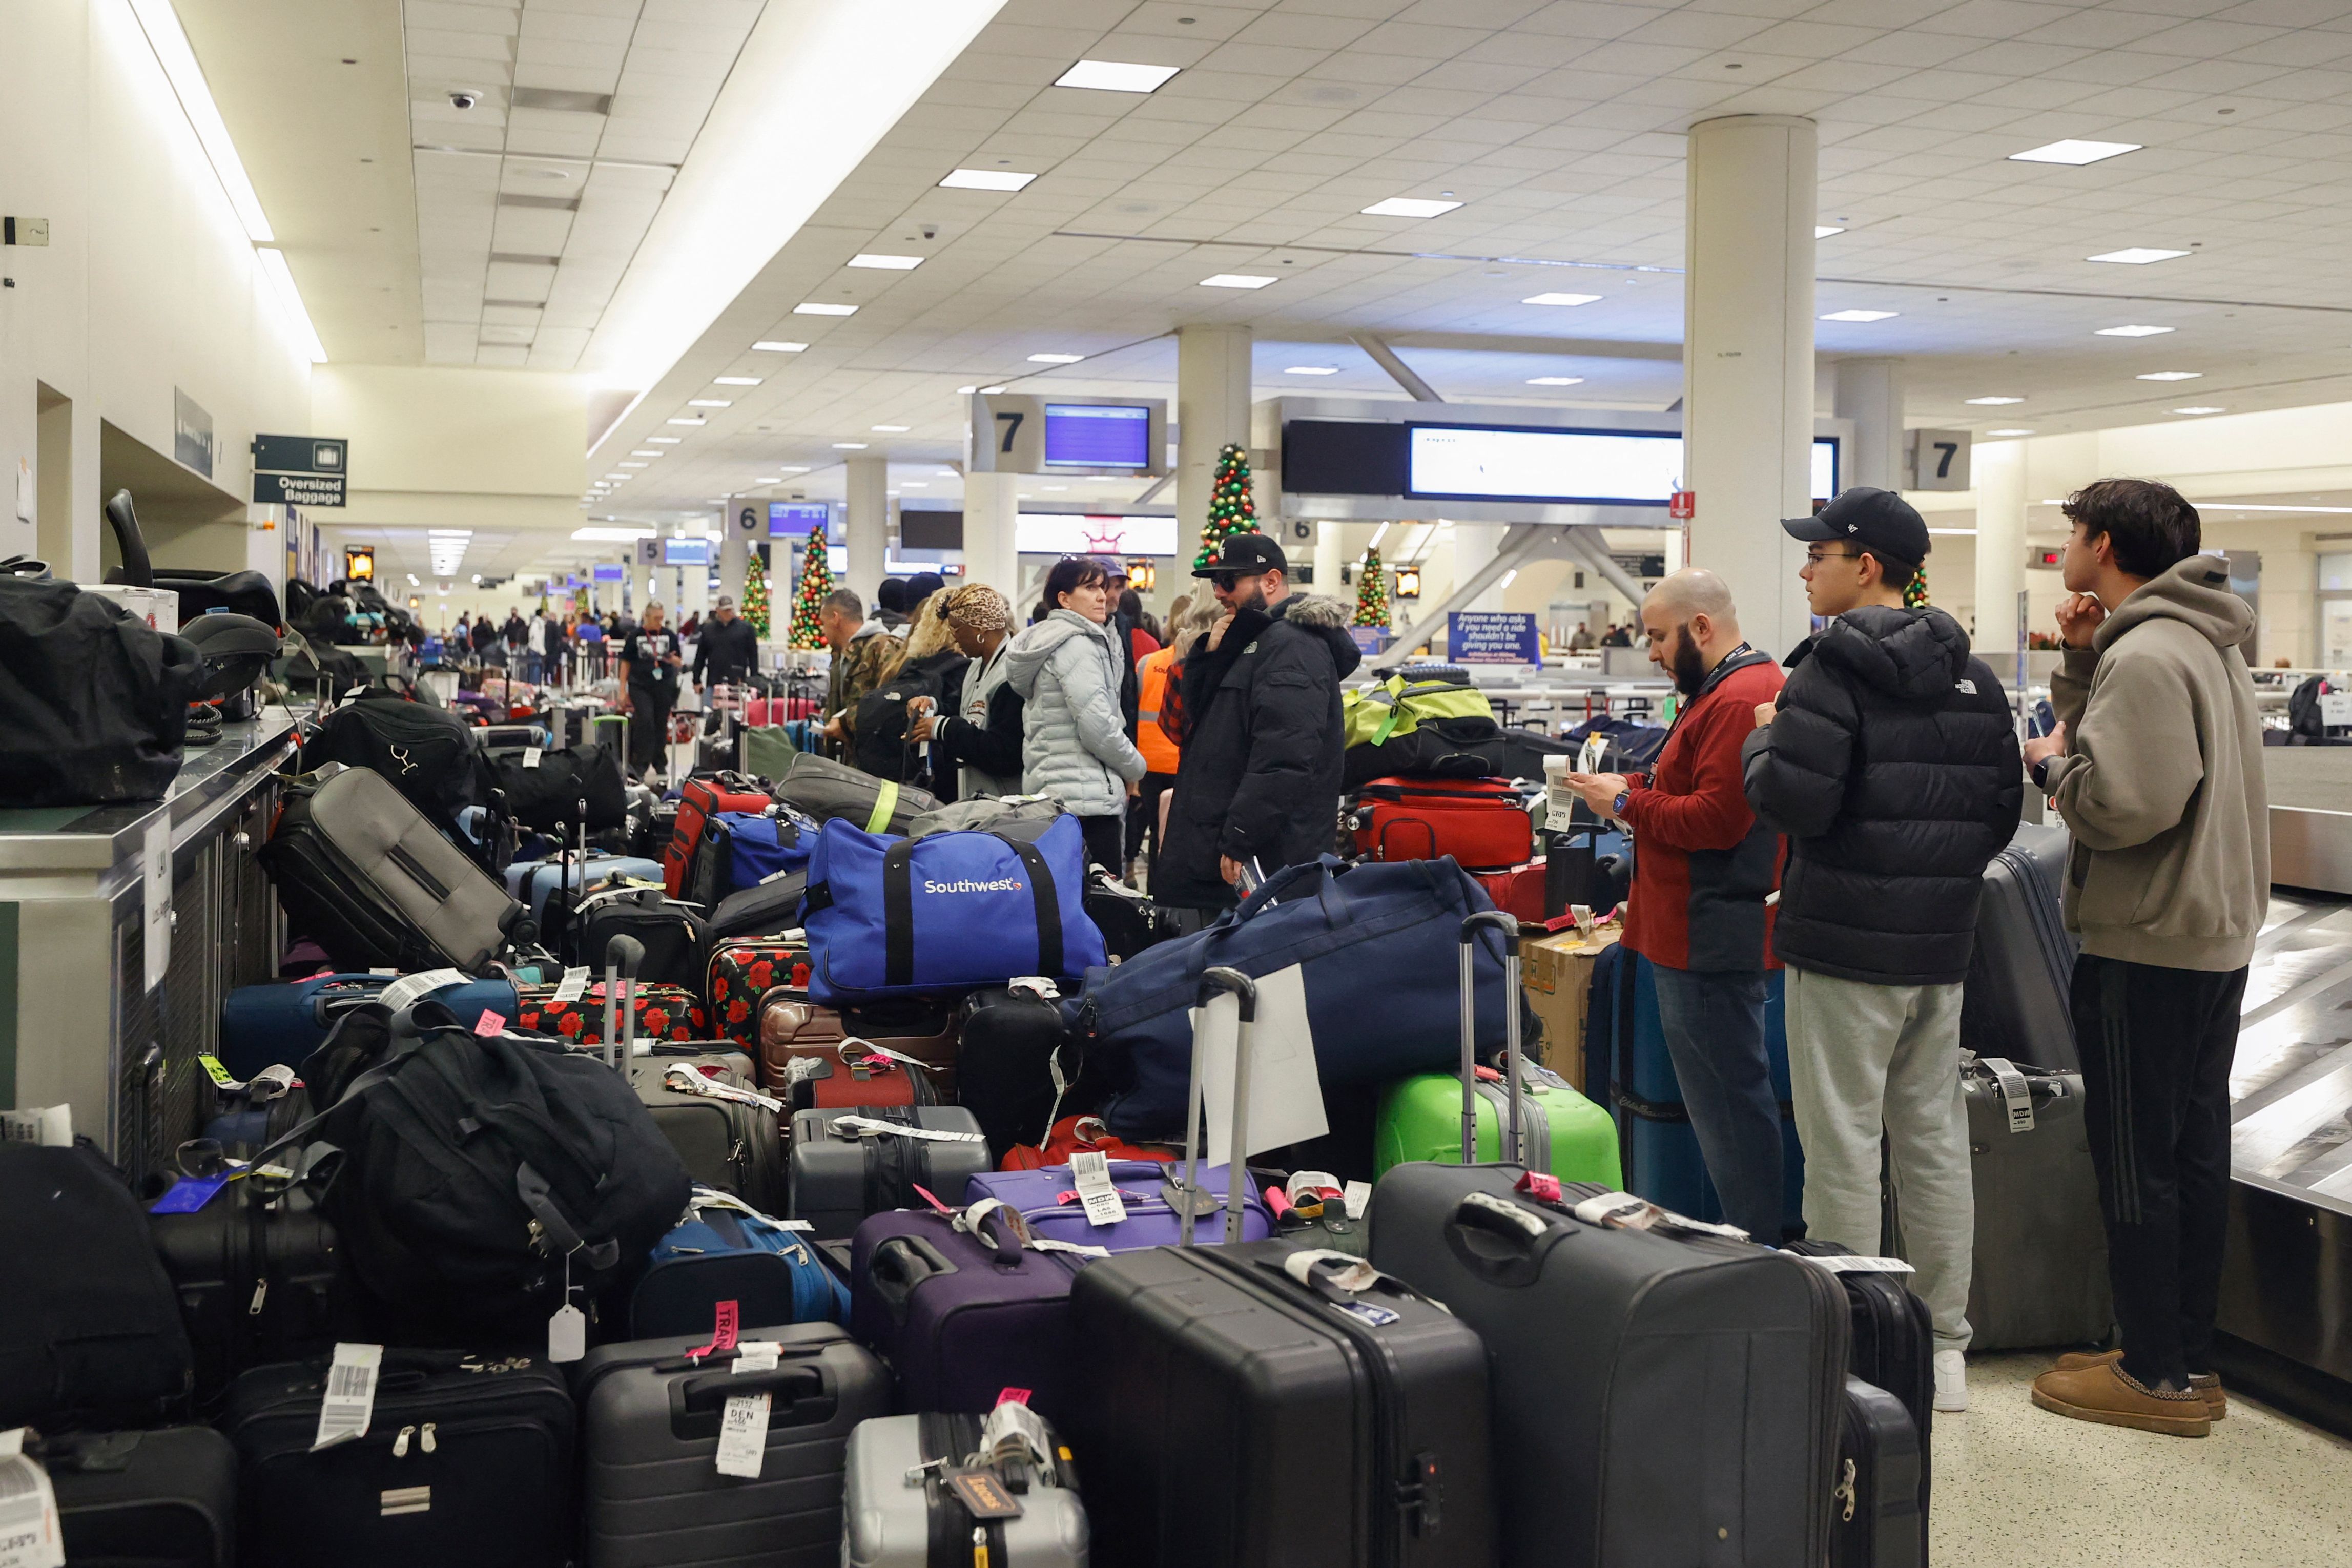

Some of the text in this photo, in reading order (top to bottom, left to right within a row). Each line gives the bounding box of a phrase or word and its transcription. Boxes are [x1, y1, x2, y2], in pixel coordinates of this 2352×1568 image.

[996, 412, 1024, 452] 7
[1933, 443, 1958, 478] 7
[279, 476, 341, 492] Oversized
[285, 488, 341, 505] Baggage
[740, 507, 757, 530] 6
[1295, 521, 1310, 539] 6
[647, 542, 658, 559] 5
[1457, 614, 1526, 624] Anyone who asks
[1465, 624, 1480, 633] you
[1482, 623, 1502, 631] need
[1511, 623, 1526, 632] ride
[1468, 632, 1517, 641] shouldn't be
[1462, 641, 1487, 652] giving
[1488, 642, 1503, 651] you
[924, 878, 1014, 893] Southwest
[1088, 1193, 1115, 1205] MDW
[730, 1409, 754, 1420] DEN
